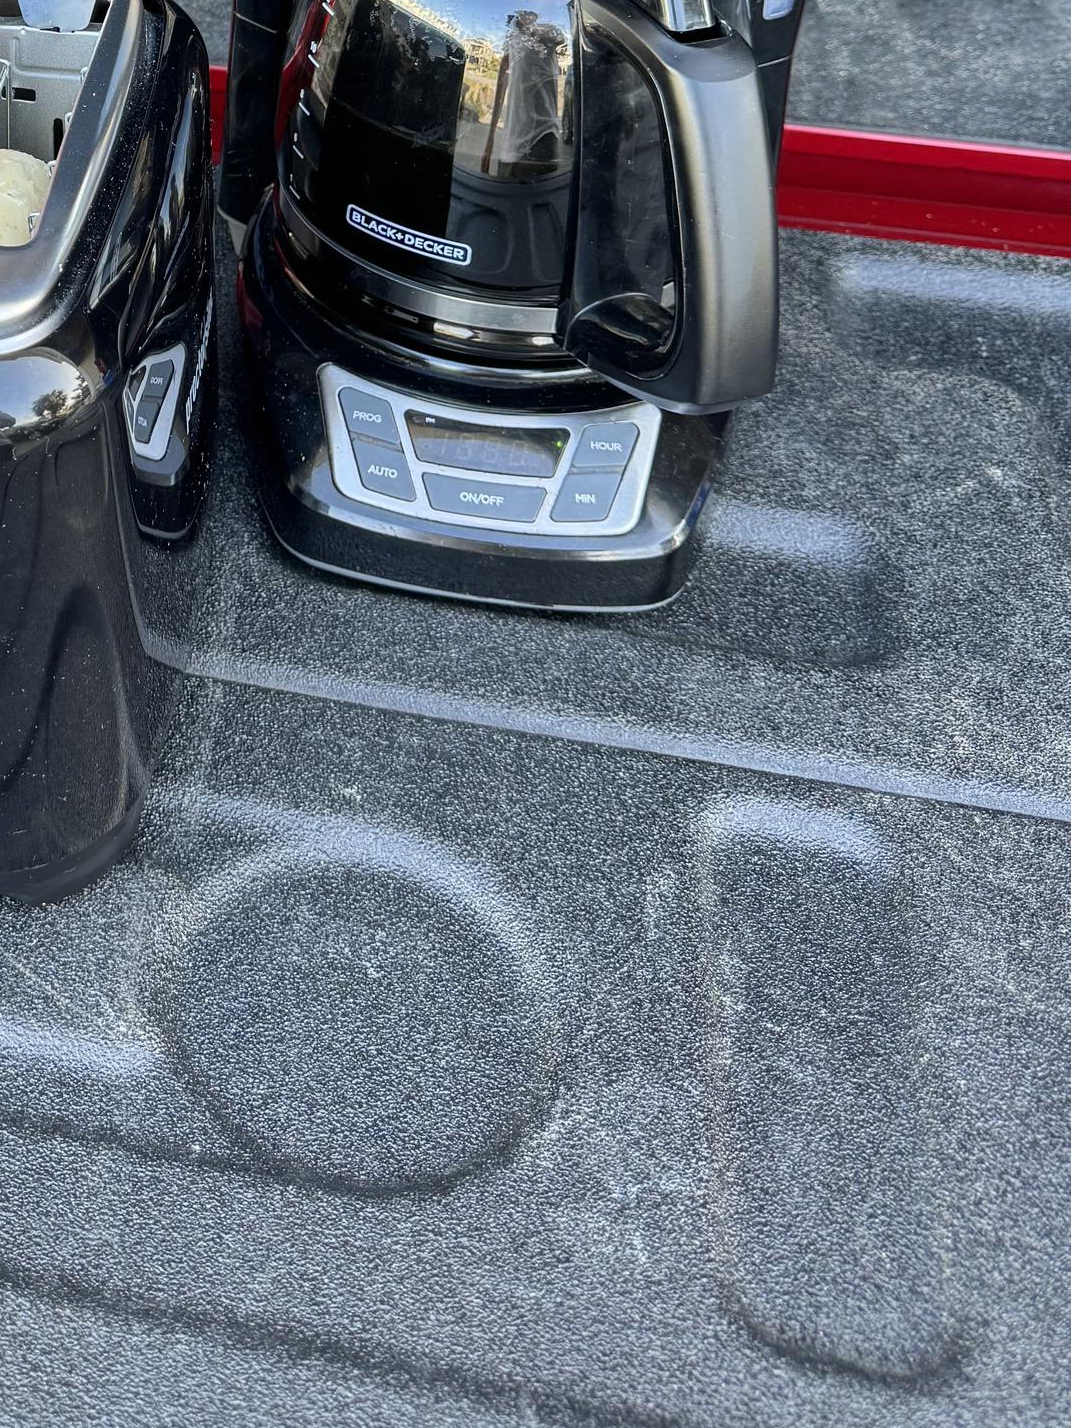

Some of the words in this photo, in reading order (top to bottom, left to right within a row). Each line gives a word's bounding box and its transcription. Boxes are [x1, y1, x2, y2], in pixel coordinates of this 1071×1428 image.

[351, 210, 465, 260] BLACK+DECKER
[352, 410, 382, 424] PROG
[590, 440, 623, 453] HOUR
[367, 464, 398, 479] AUTO
[459, 491, 505, 507] ON/OFF
[575, 493, 596, 505] MIN
